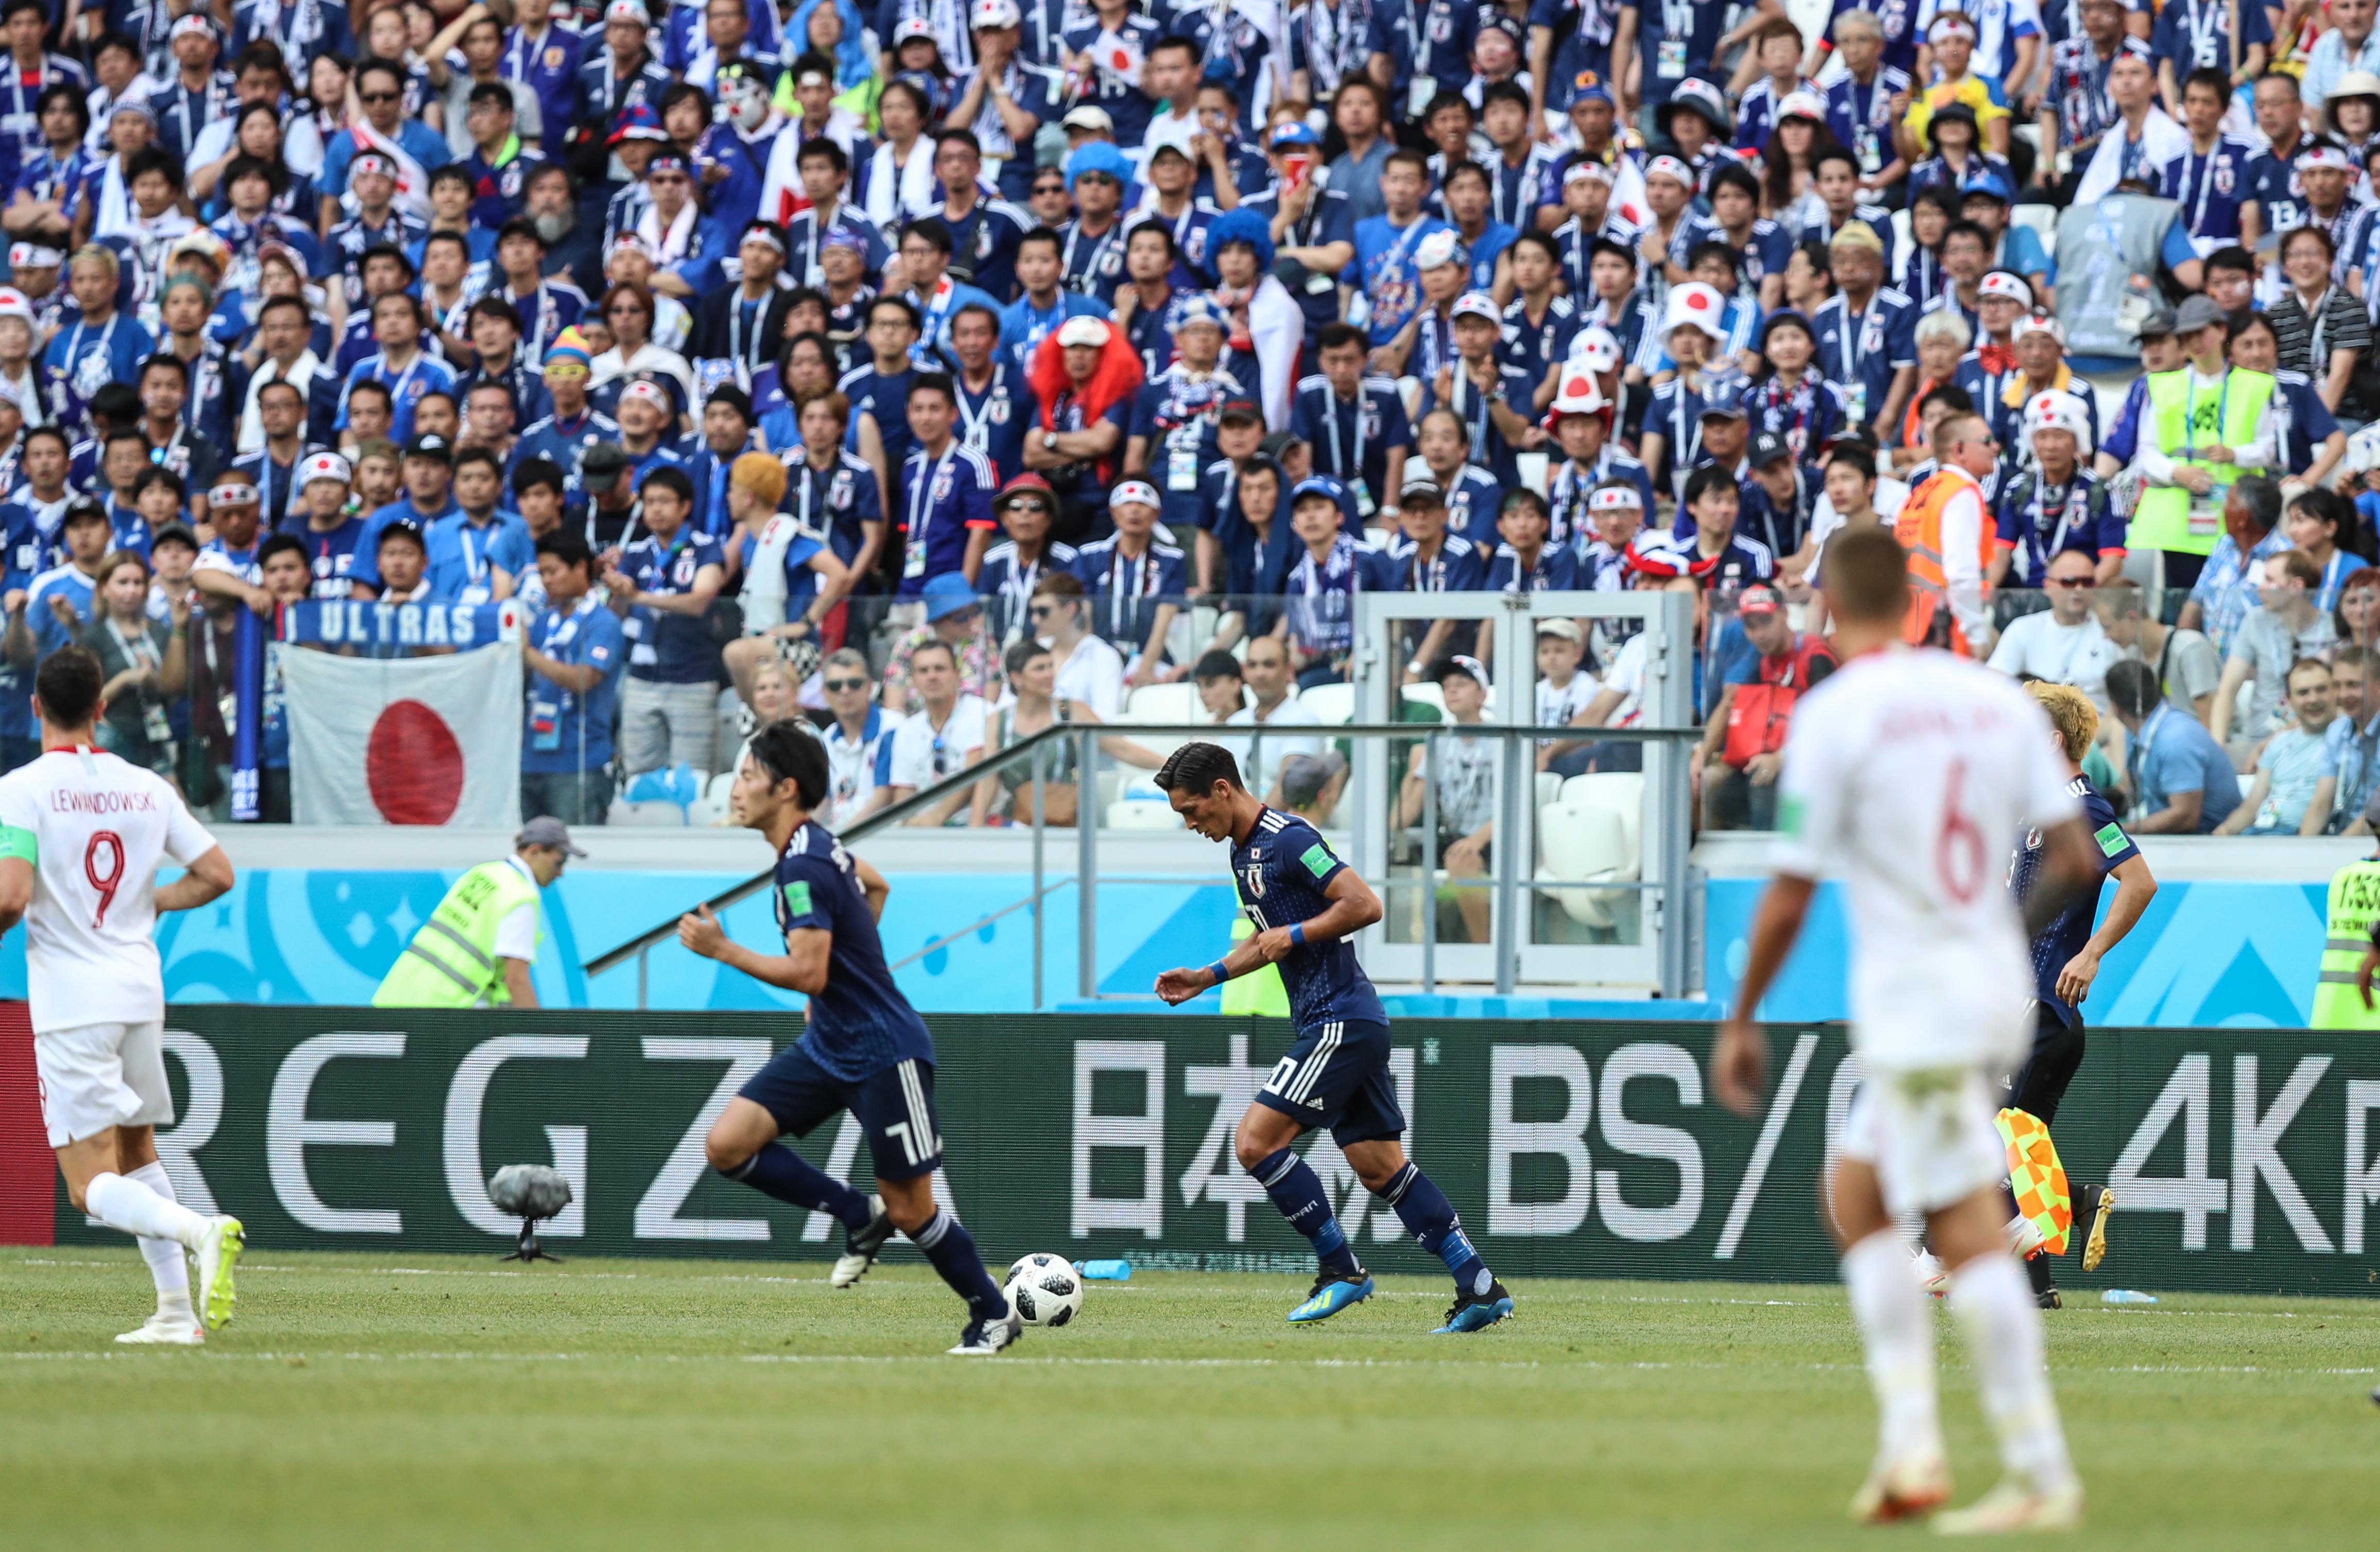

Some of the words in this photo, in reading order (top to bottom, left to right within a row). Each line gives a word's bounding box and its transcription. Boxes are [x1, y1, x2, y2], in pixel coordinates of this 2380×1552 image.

[320, 601, 475, 644] ULTRAS
[1934, 756, 1988, 907] 6
[85, 829, 125, 930] 9
[885, 1121, 919, 1167] 7
